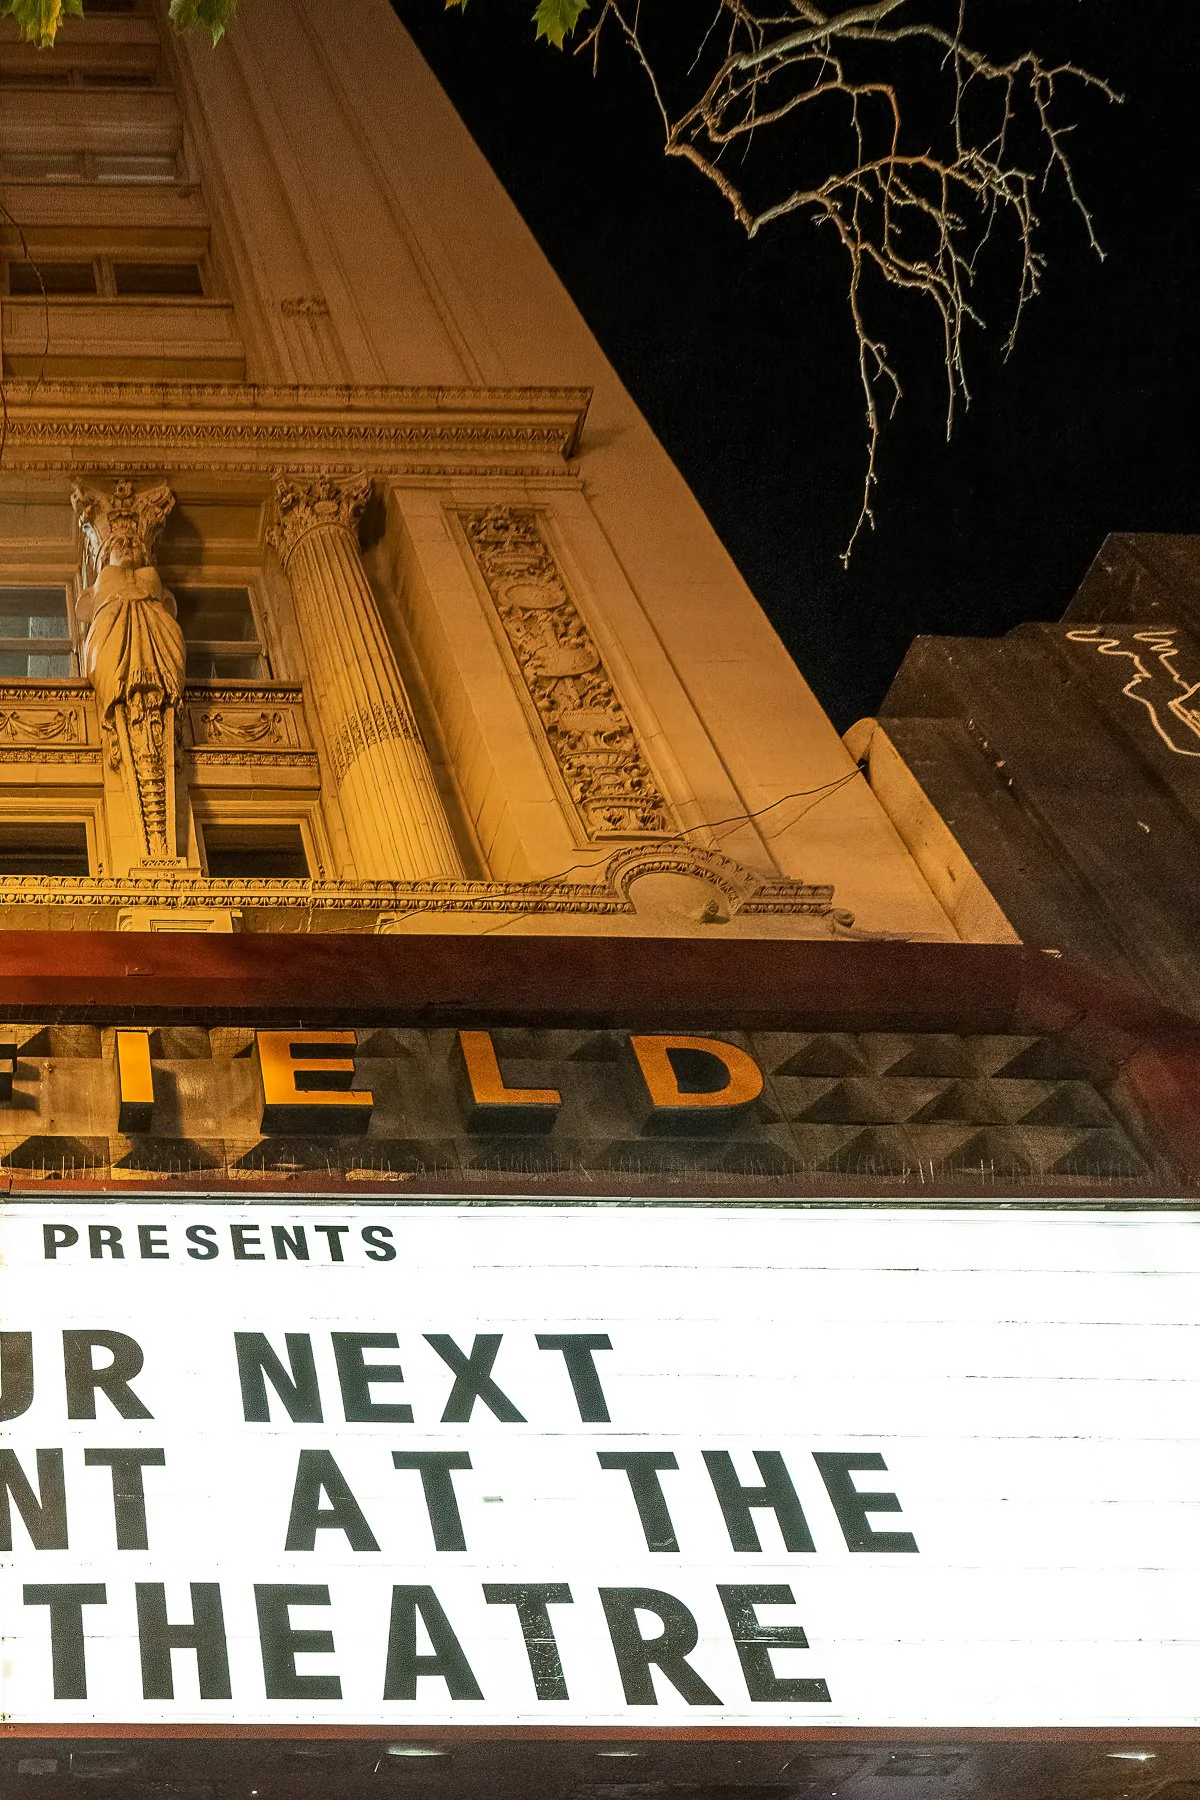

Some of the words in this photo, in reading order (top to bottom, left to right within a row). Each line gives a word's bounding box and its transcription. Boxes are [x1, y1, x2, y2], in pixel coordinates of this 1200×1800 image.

[42, 1223, 398, 1263] PRESENTS
[233, 1331, 614, 1424] NEXT
[283, 1448, 474, 1552] AT
[595, 1449, 921, 1554] THE
[22, 1580, 833, 1707] THEATRE
